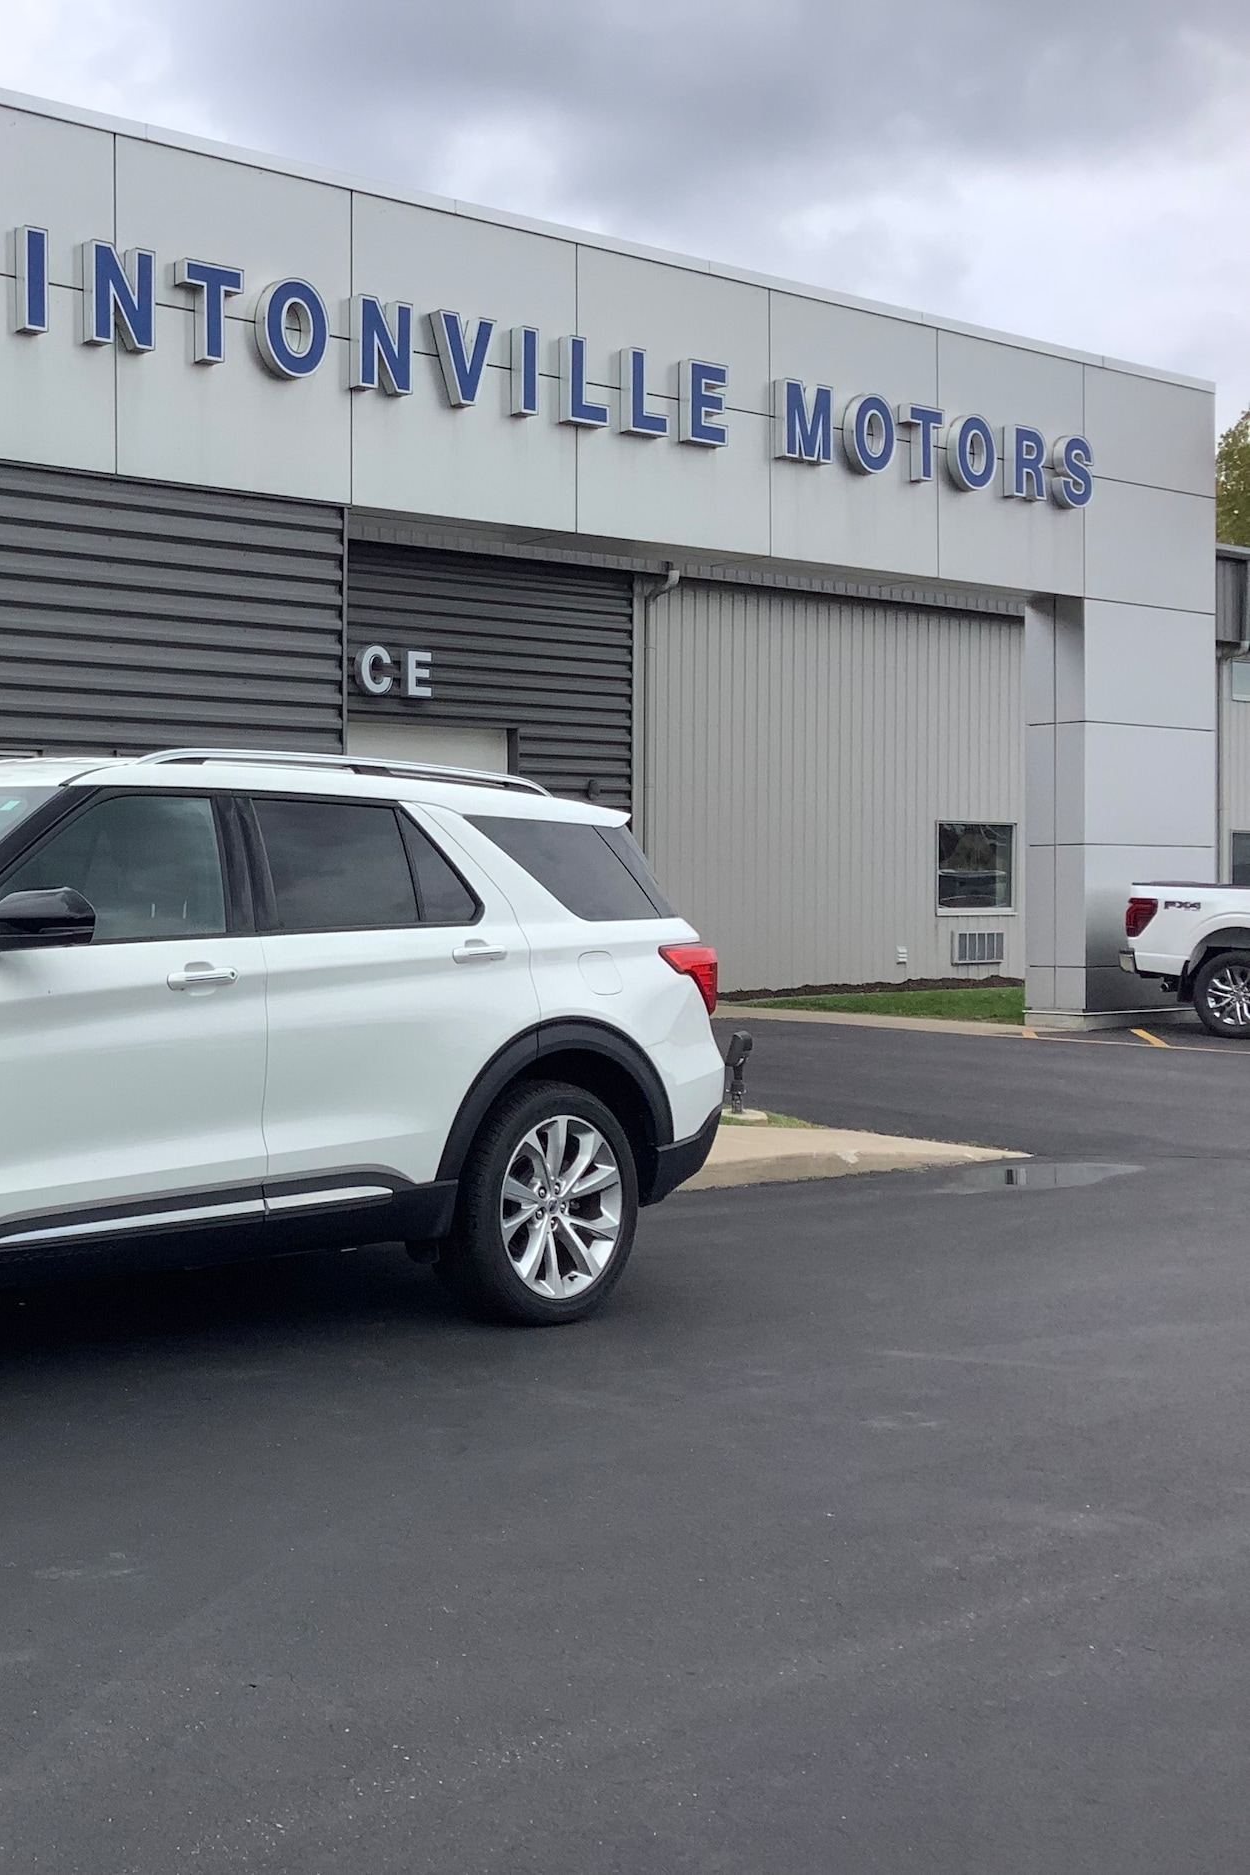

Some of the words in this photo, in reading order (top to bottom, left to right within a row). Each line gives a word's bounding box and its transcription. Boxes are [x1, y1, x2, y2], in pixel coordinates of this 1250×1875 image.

[774, 377, 1094, 509] MOTORS
[354, 643, 434, 699] CE
[1164, 901, 1201, 909] FX4
